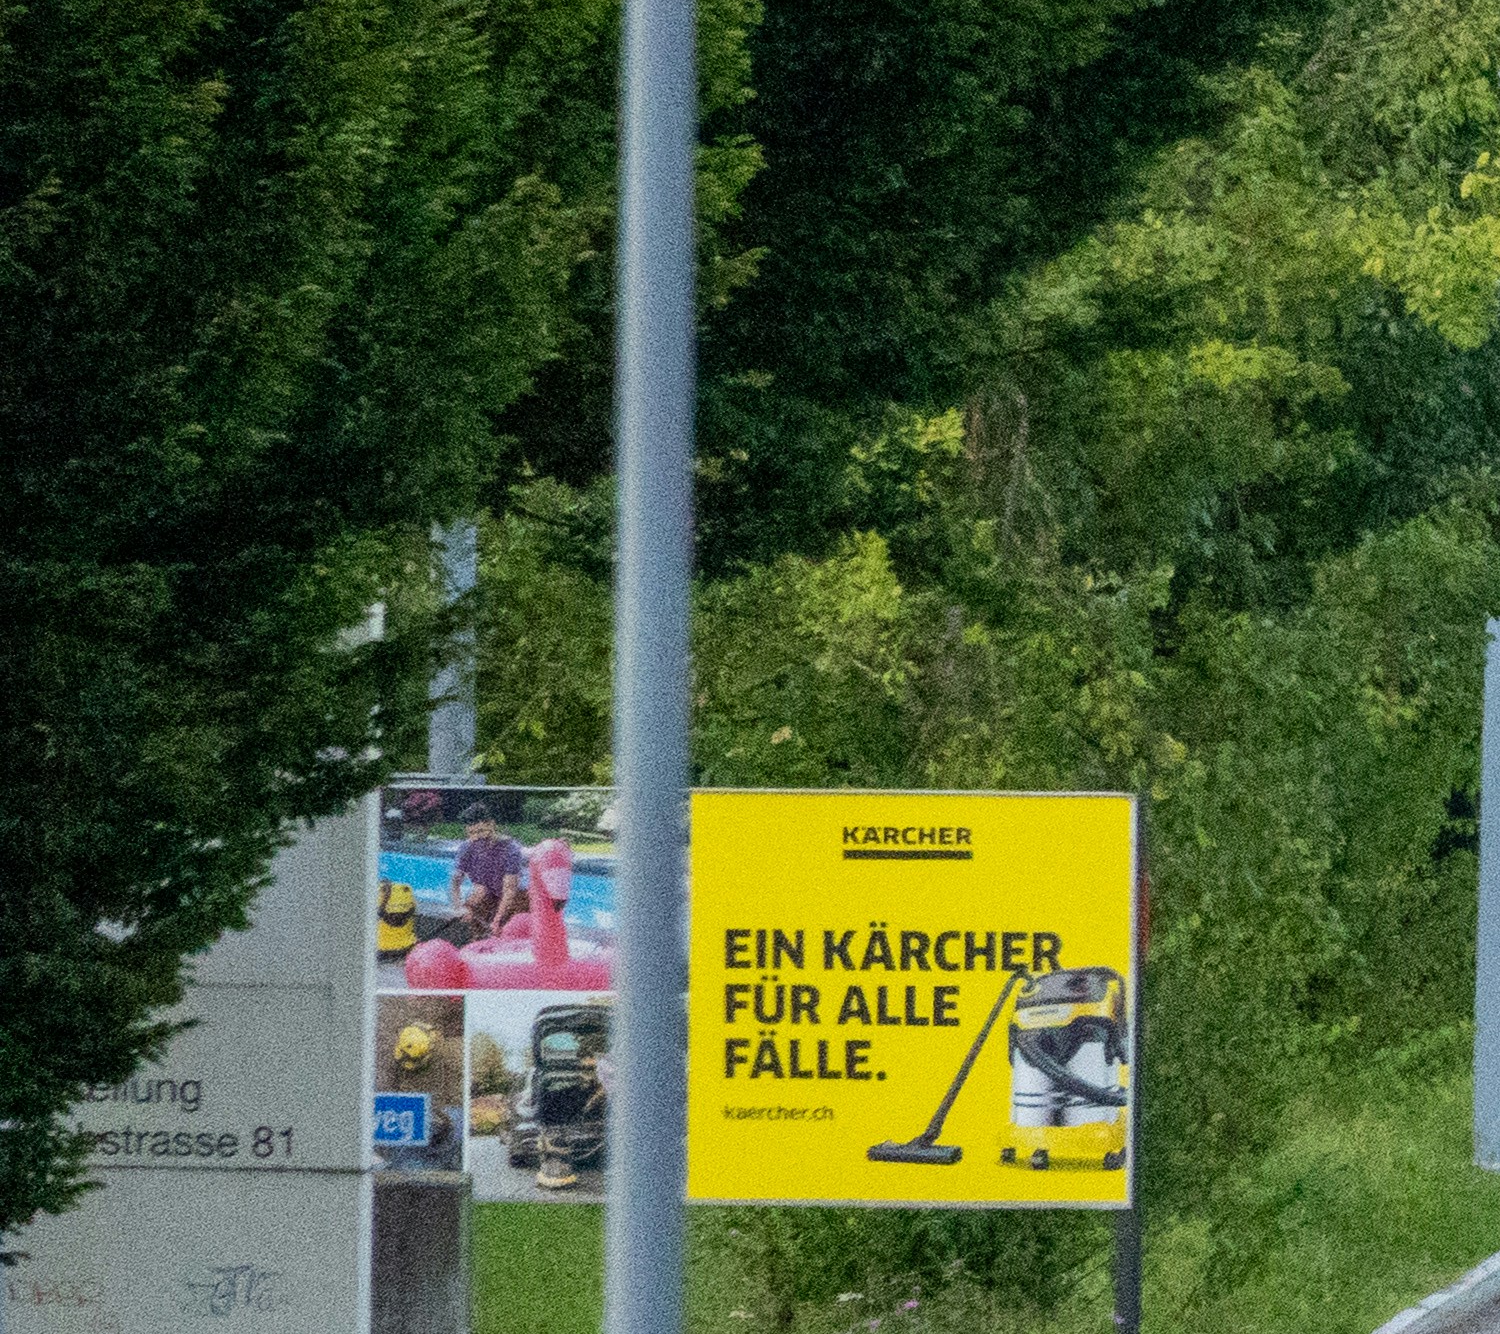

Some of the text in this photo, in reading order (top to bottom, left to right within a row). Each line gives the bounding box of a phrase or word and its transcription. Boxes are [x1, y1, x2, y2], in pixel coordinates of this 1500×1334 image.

[842, 826, 973, 846] KÄRCHER
[724, 921, 1063, 972] EIN KÄRCHER
[724, 975, 961, 1027] FÜR ALLE
[724, 1030, 887, 1081] FÄLLE.
[722, 1104, 834, 1122] kaercher.ch
[79, 1123, 295, 1159] strasse 81
